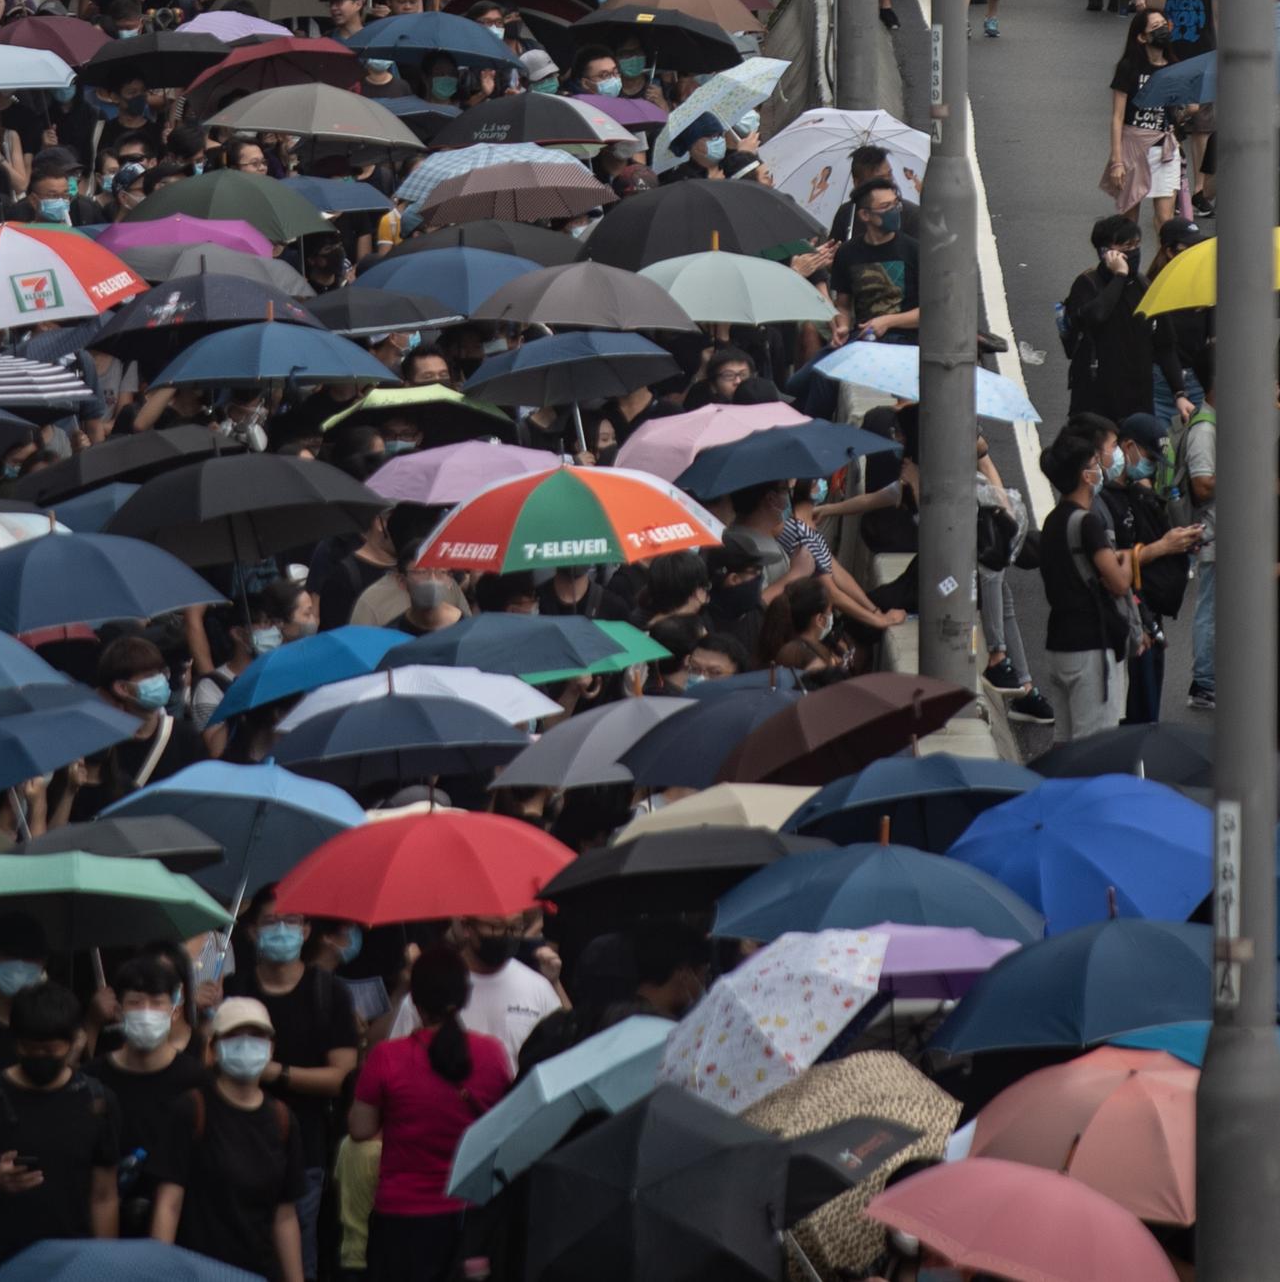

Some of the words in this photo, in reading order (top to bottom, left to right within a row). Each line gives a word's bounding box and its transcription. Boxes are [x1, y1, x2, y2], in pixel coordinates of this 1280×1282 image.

[931, 30, 941, 101] 31839
[473, 131, 507, 141] Young
[482, 123, 511, 132] Live
[931, 120, 941, 142] A
[524, 538, 610, 560] 7-ELEVEN
[1219, 967, 1236, 1000] A
